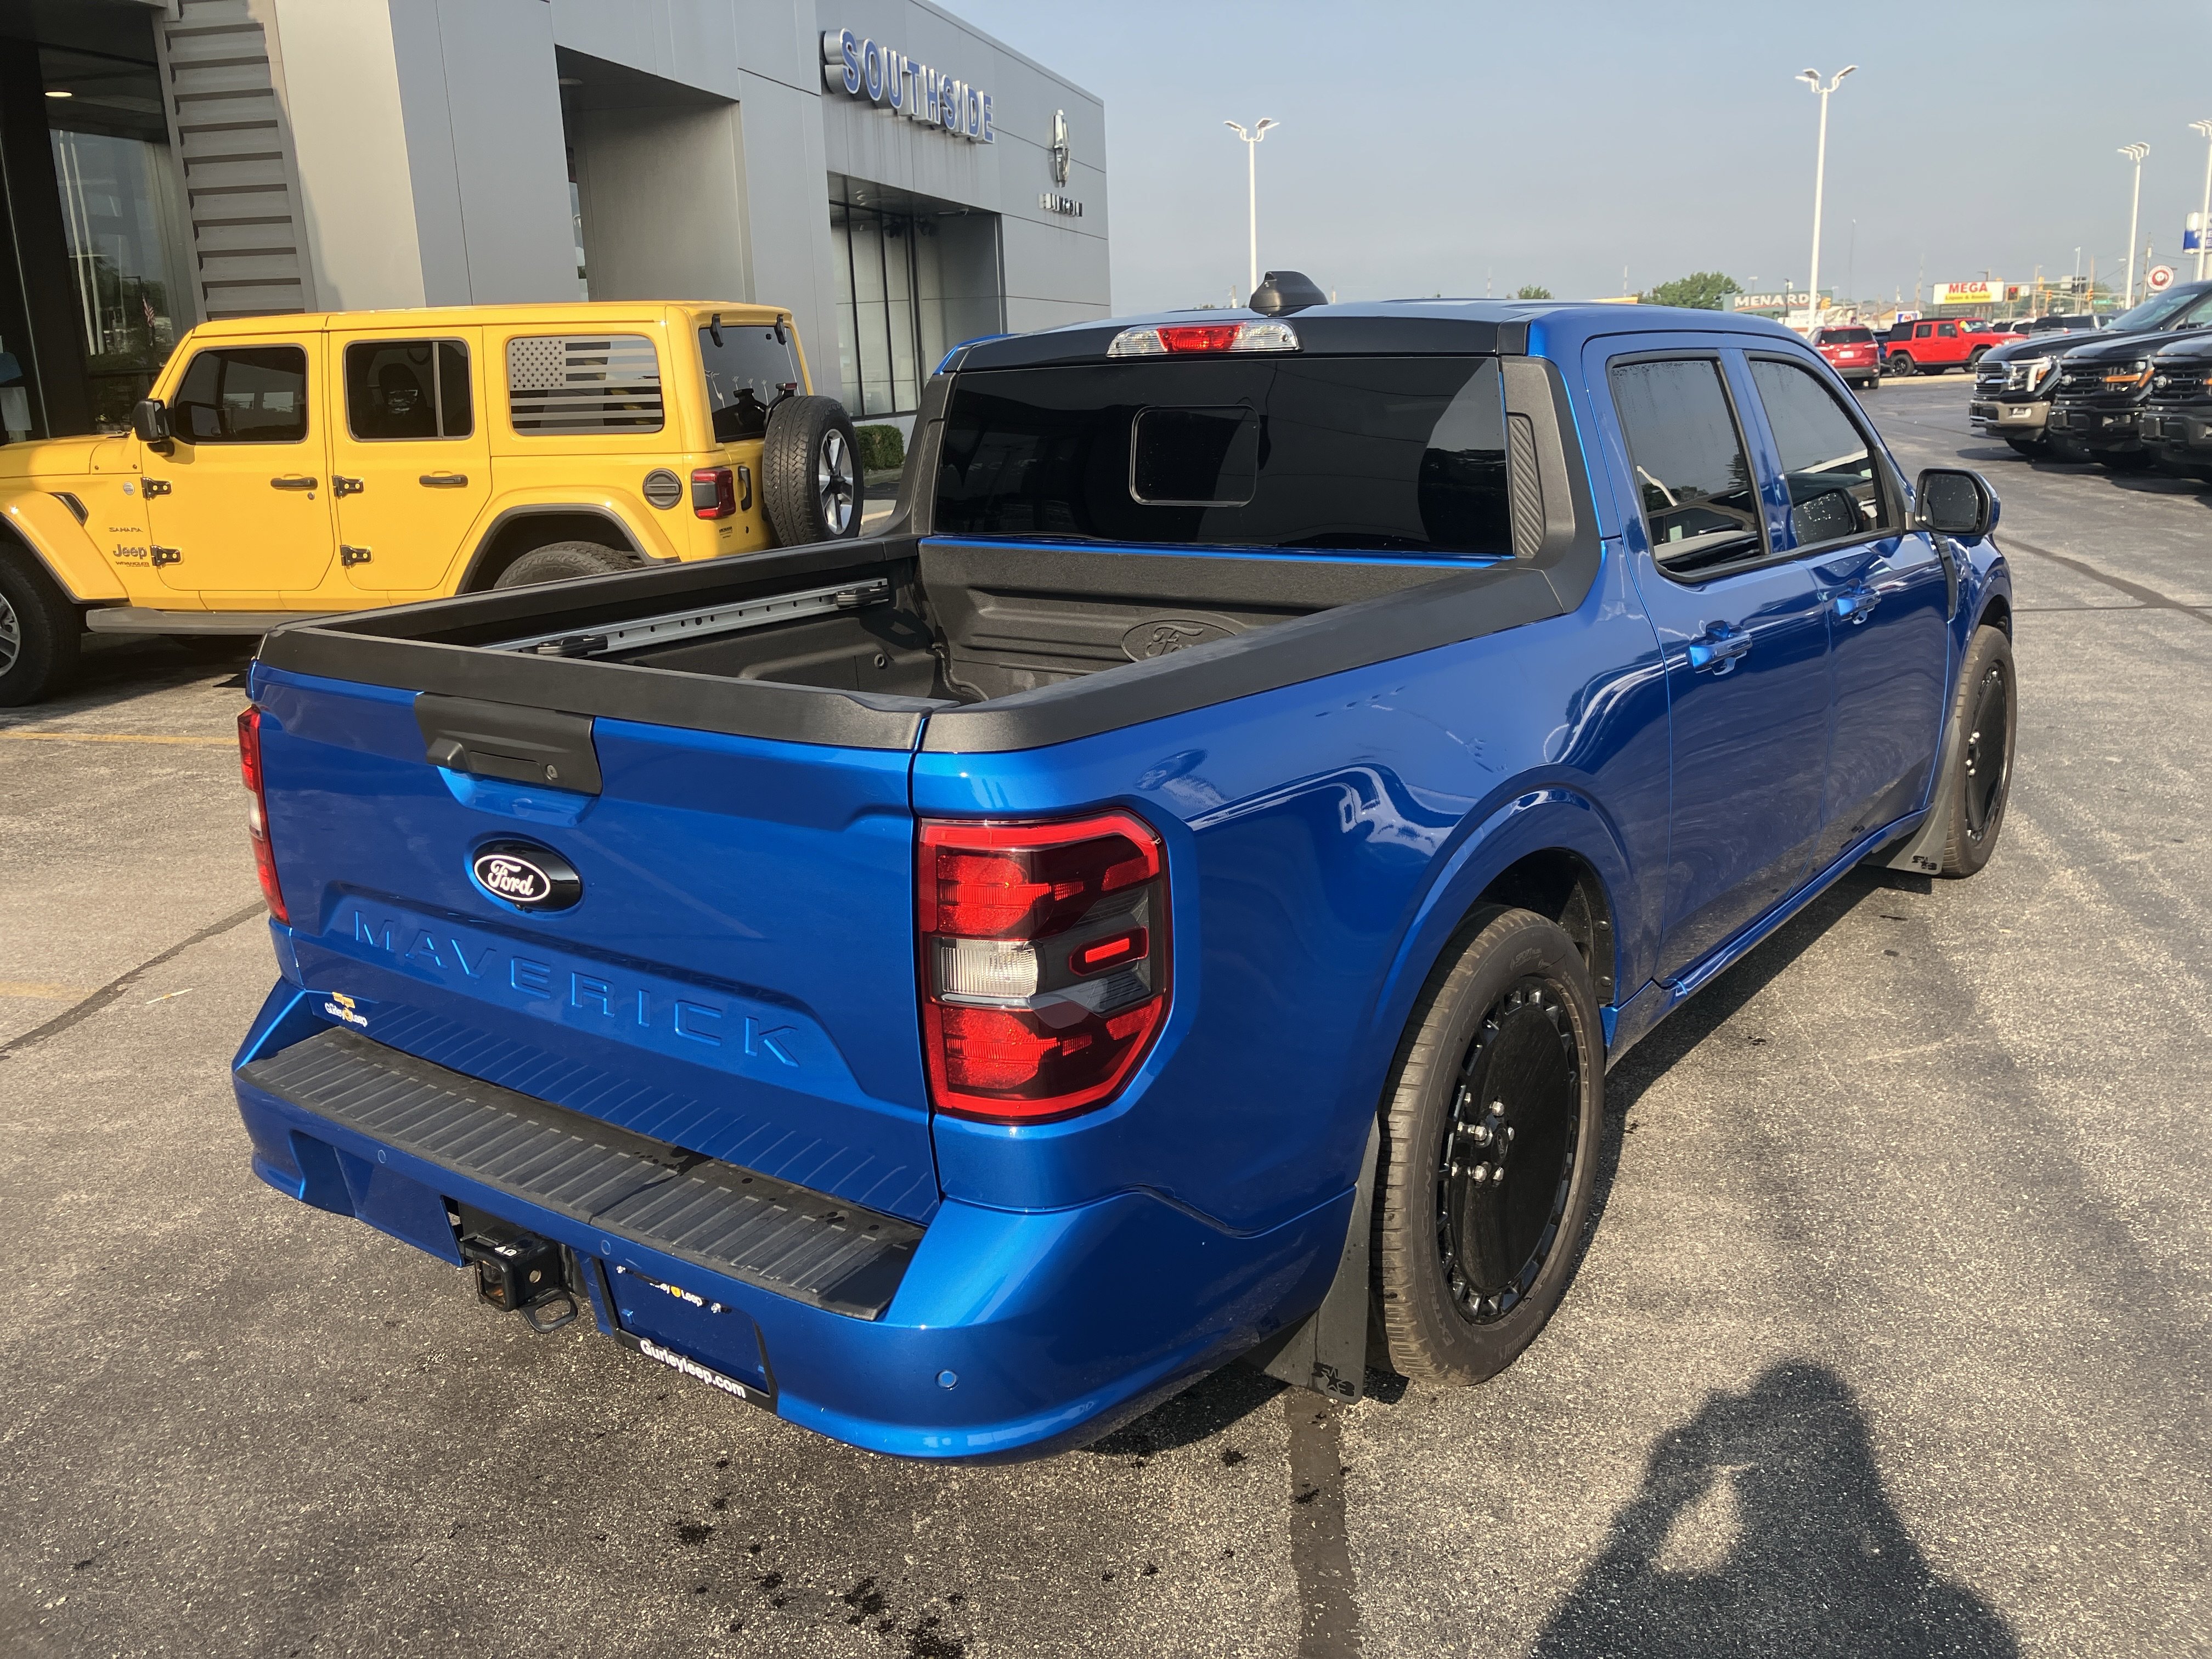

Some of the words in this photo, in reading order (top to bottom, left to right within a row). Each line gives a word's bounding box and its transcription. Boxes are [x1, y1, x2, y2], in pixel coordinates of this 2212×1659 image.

[840, 28, 995, 144] SOUTHSIDE
[1949, 282, 1988, 294] MEGA
[112, 544, 148, 560] Jeep
[487, 860, 534, 896] Ford
[354, 910, 800, 1068] MAVERICK
[640, 1339, 746, 1399] Gurleyleep.com
